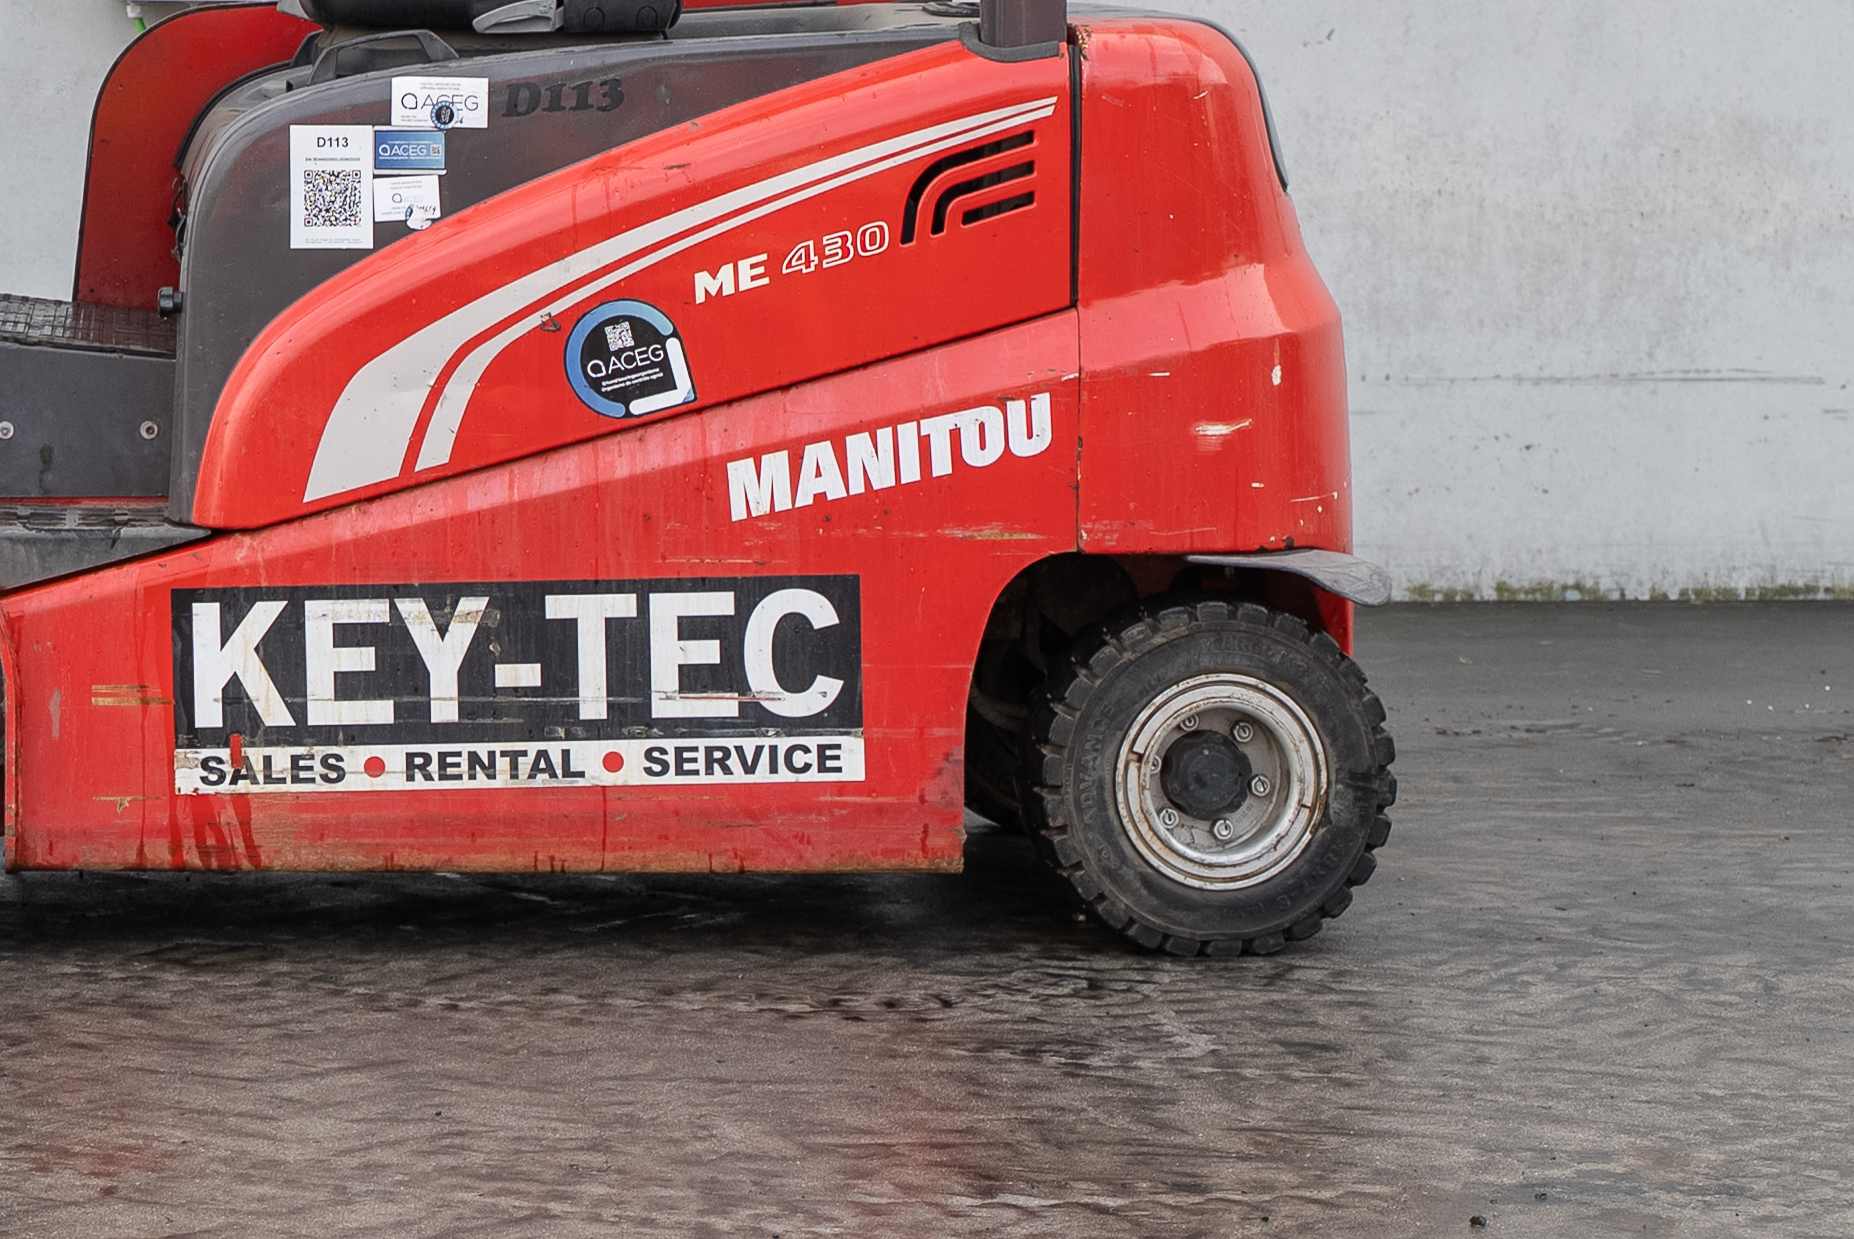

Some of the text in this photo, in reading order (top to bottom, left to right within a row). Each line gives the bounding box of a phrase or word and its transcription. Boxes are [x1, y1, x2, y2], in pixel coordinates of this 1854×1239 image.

[501, 78, 625, 117] D113
[317, 136, 349, 148] D113
[694, 221, 890, 305] ME 430
[727, 392, 1054, 523] MANITOU
[192, 588, 845, 729] KEY-TEC
[199, 743, 843, 787] SALES RENTAL SERVICE
[1078, 700, 1118, 825] ADVANCE
